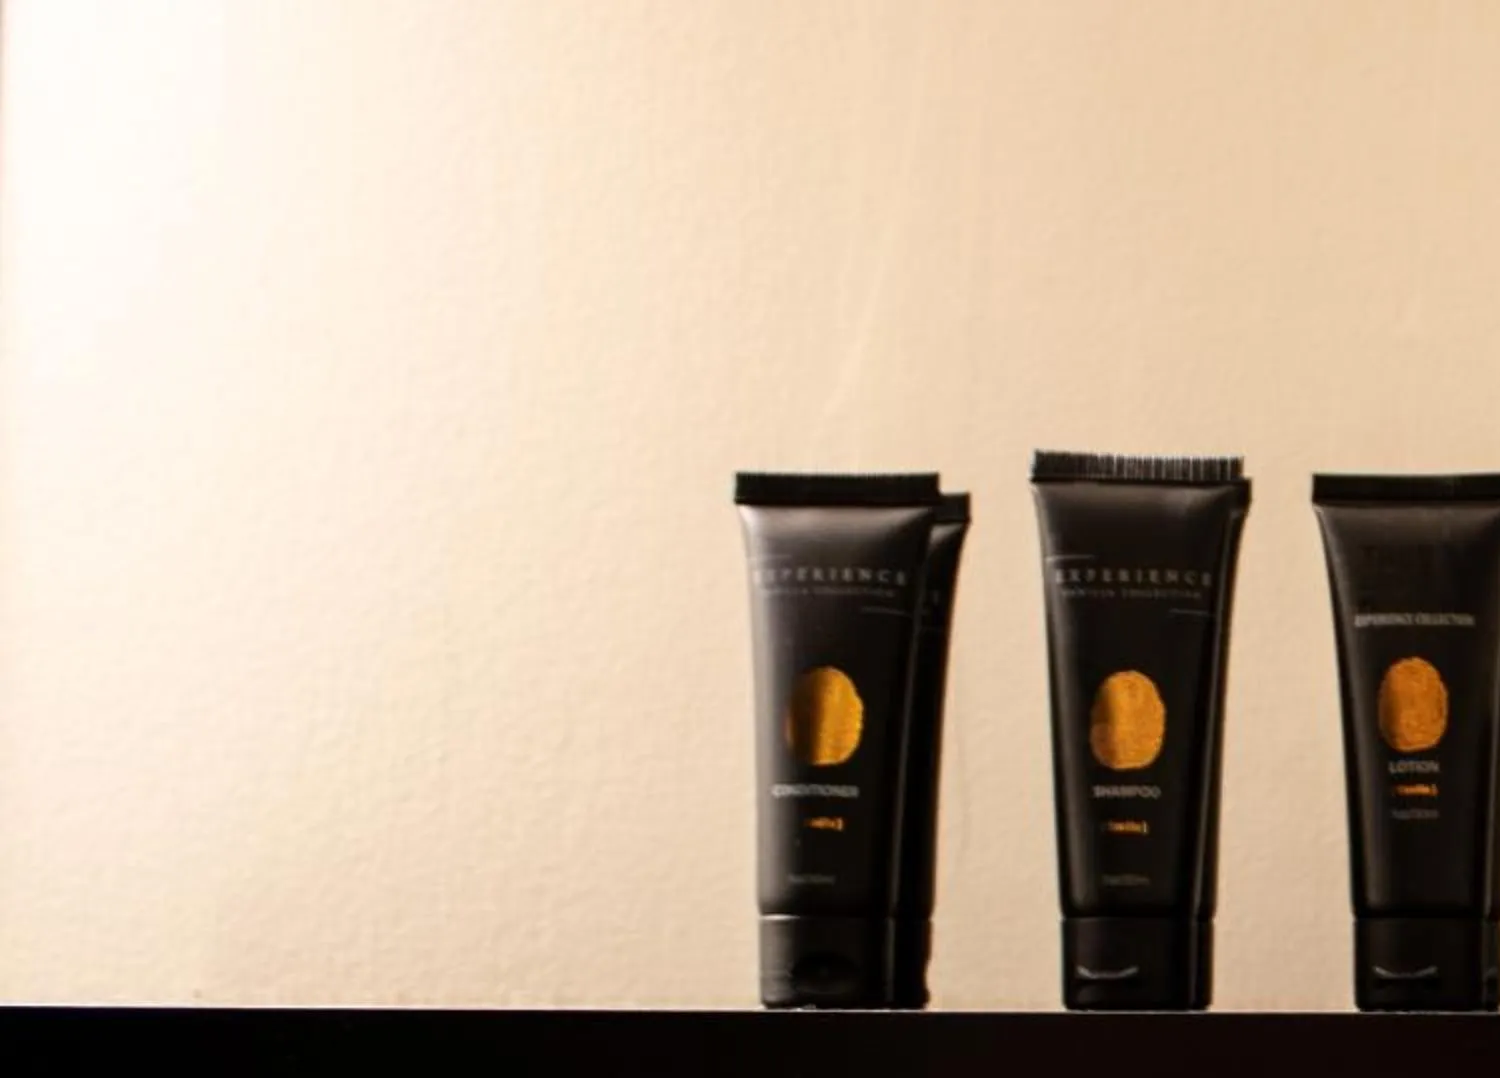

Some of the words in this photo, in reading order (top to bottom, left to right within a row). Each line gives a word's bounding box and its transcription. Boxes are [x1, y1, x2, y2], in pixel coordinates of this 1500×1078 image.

[1055, 568, 1213, 586] EXPERIENCE
[1387, 760, 1440, 775] LOTION
[1093, 784, 1162, 800] SHAMPOO
